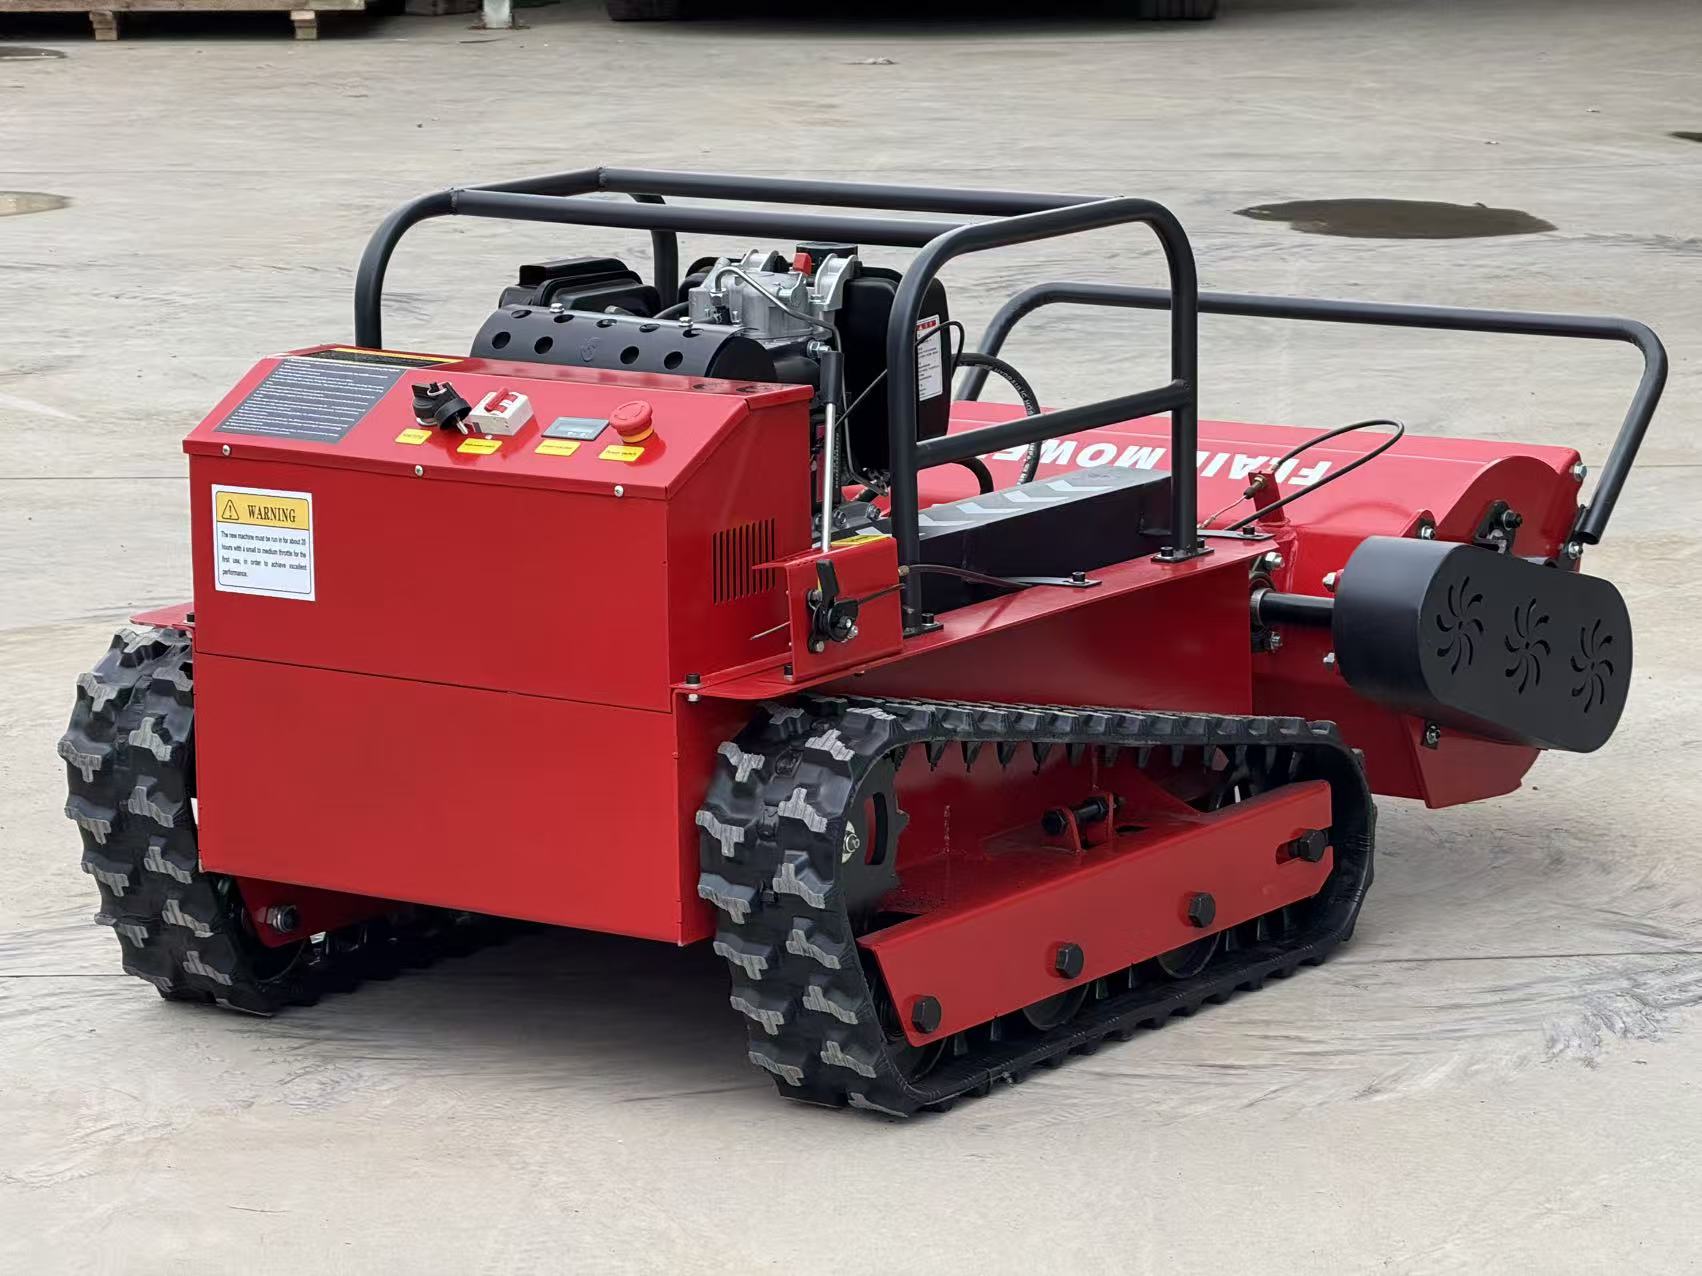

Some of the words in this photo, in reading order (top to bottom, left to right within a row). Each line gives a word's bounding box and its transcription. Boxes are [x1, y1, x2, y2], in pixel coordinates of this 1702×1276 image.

[247, 504, 297, 523] WARNING
[220, 530, 228, 538] The
[238, 533, 254, 541] machine
